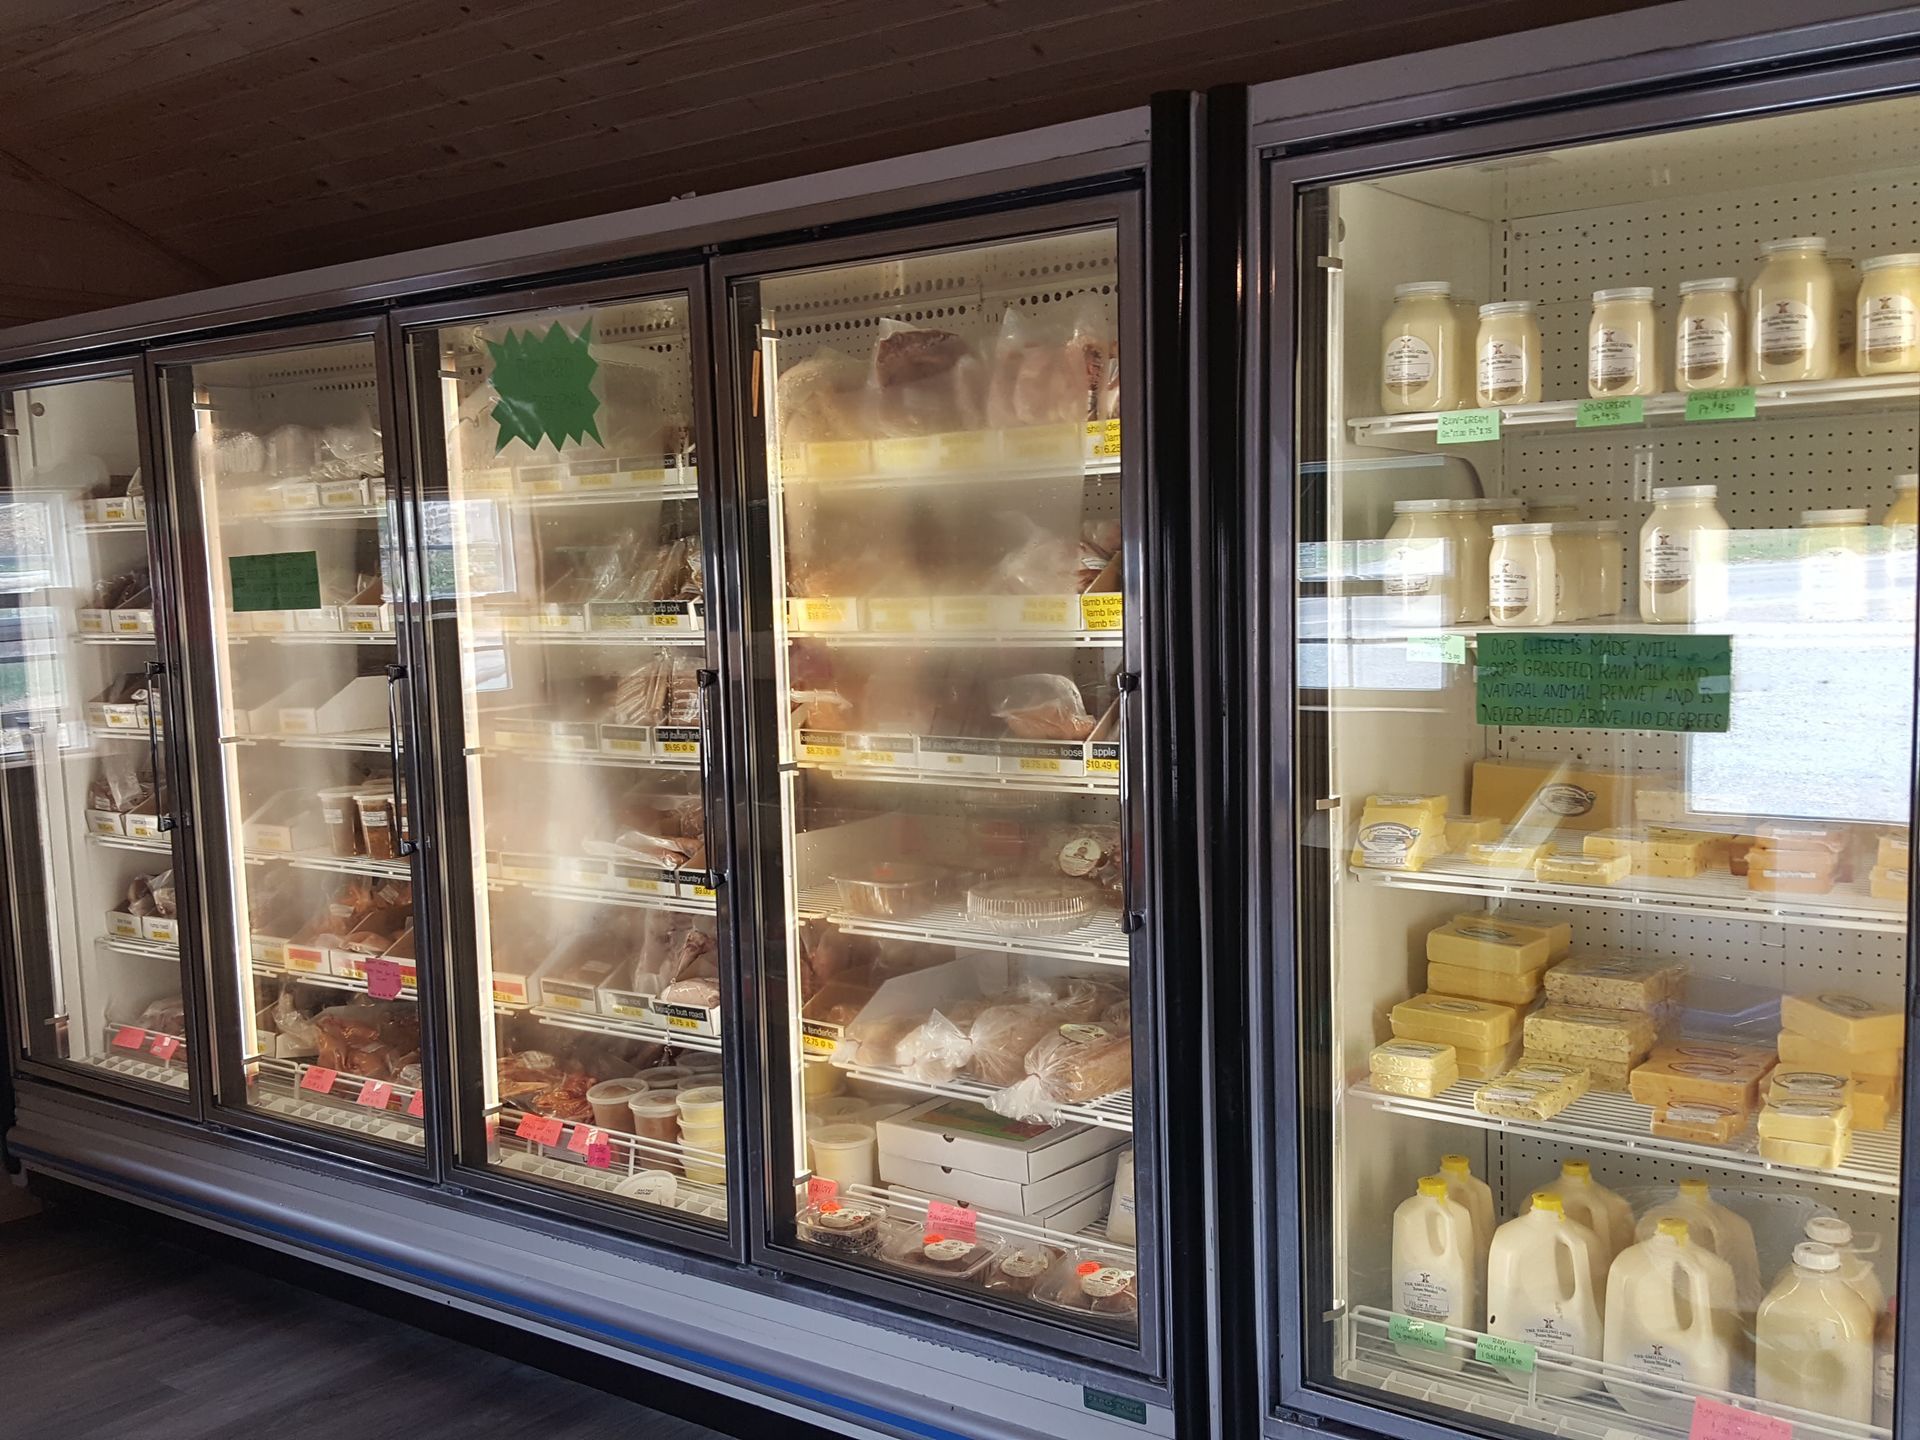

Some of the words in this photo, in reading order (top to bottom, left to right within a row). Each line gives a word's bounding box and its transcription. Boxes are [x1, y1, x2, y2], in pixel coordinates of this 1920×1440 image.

[1083, 597, 1101, 607] lamb
[1087, 608, 1106, 617] lamb
[1088, 619, 1107, 628] lamb
[1491, 638, 1517, 656] OUR
[1522, 638, 1564, 656] CHEESE
[1570, 638, 1582, 656] IS
[1590, 638, 1631, 657] MADE
[1637, 641, 1678, 659] WITH
[1599, 663, 1630, 680] RAW
[1633, 663, 1670, 681] MILK
[1677, 667, 1710, 682] AND
[1482, 682, 1538, 699] NATURAL
[1543, 684, 1592, 701] ANIMAL
[1599, 684, 1658, 704] RENNET
[1664, 687, 1694, 706] AND
[1481, 704, 1524, 722] NEVER
[1526, 706, 1574, 724] HEATED
[1630, 711, 1653, 726] 110
[1656, 711, 1722, 729] DEGREES
[1060, 748, 1083, 758] loose
[1093, 747, 1117, 758] apple
[1086, 760, 1112, 770] $10.49
[679, 875, 701, 885] country
[689, 1011, 705, 1021] roast
[1499, 1345, 1517, 1355] MILK
